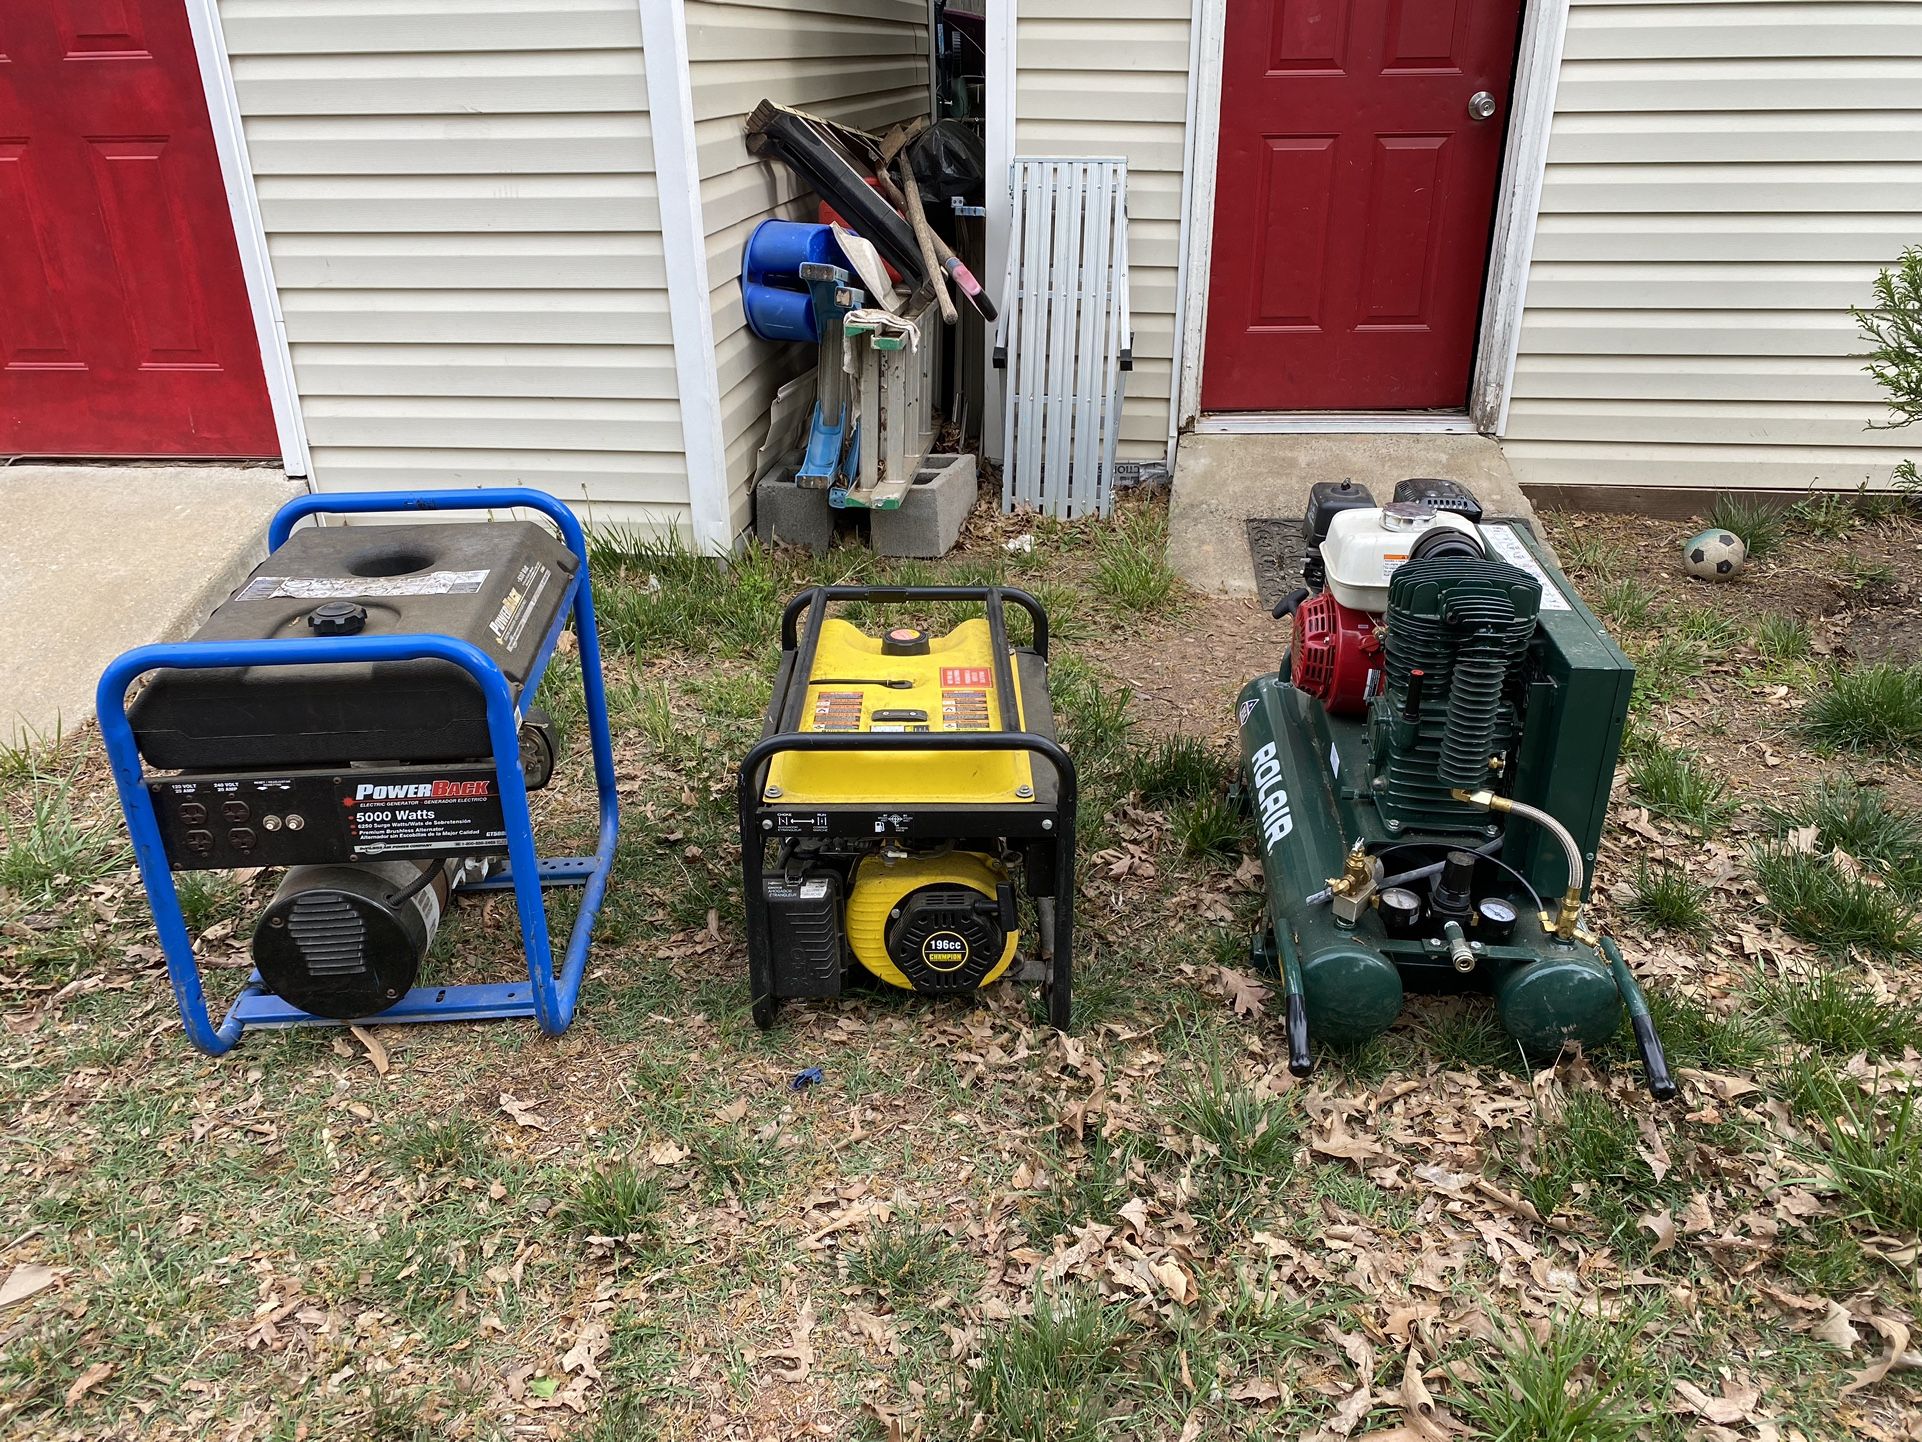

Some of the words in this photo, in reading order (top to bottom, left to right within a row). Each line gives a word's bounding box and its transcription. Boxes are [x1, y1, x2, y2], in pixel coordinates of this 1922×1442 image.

[1252, 741, 1293, 852] ROLAIR
[356, 812, 392, 822] 5000
[396, 810, 435, 820] Watts
[930, 940, 962, 950] 196cc
[930, 953, 962, 962] CHAMPION
